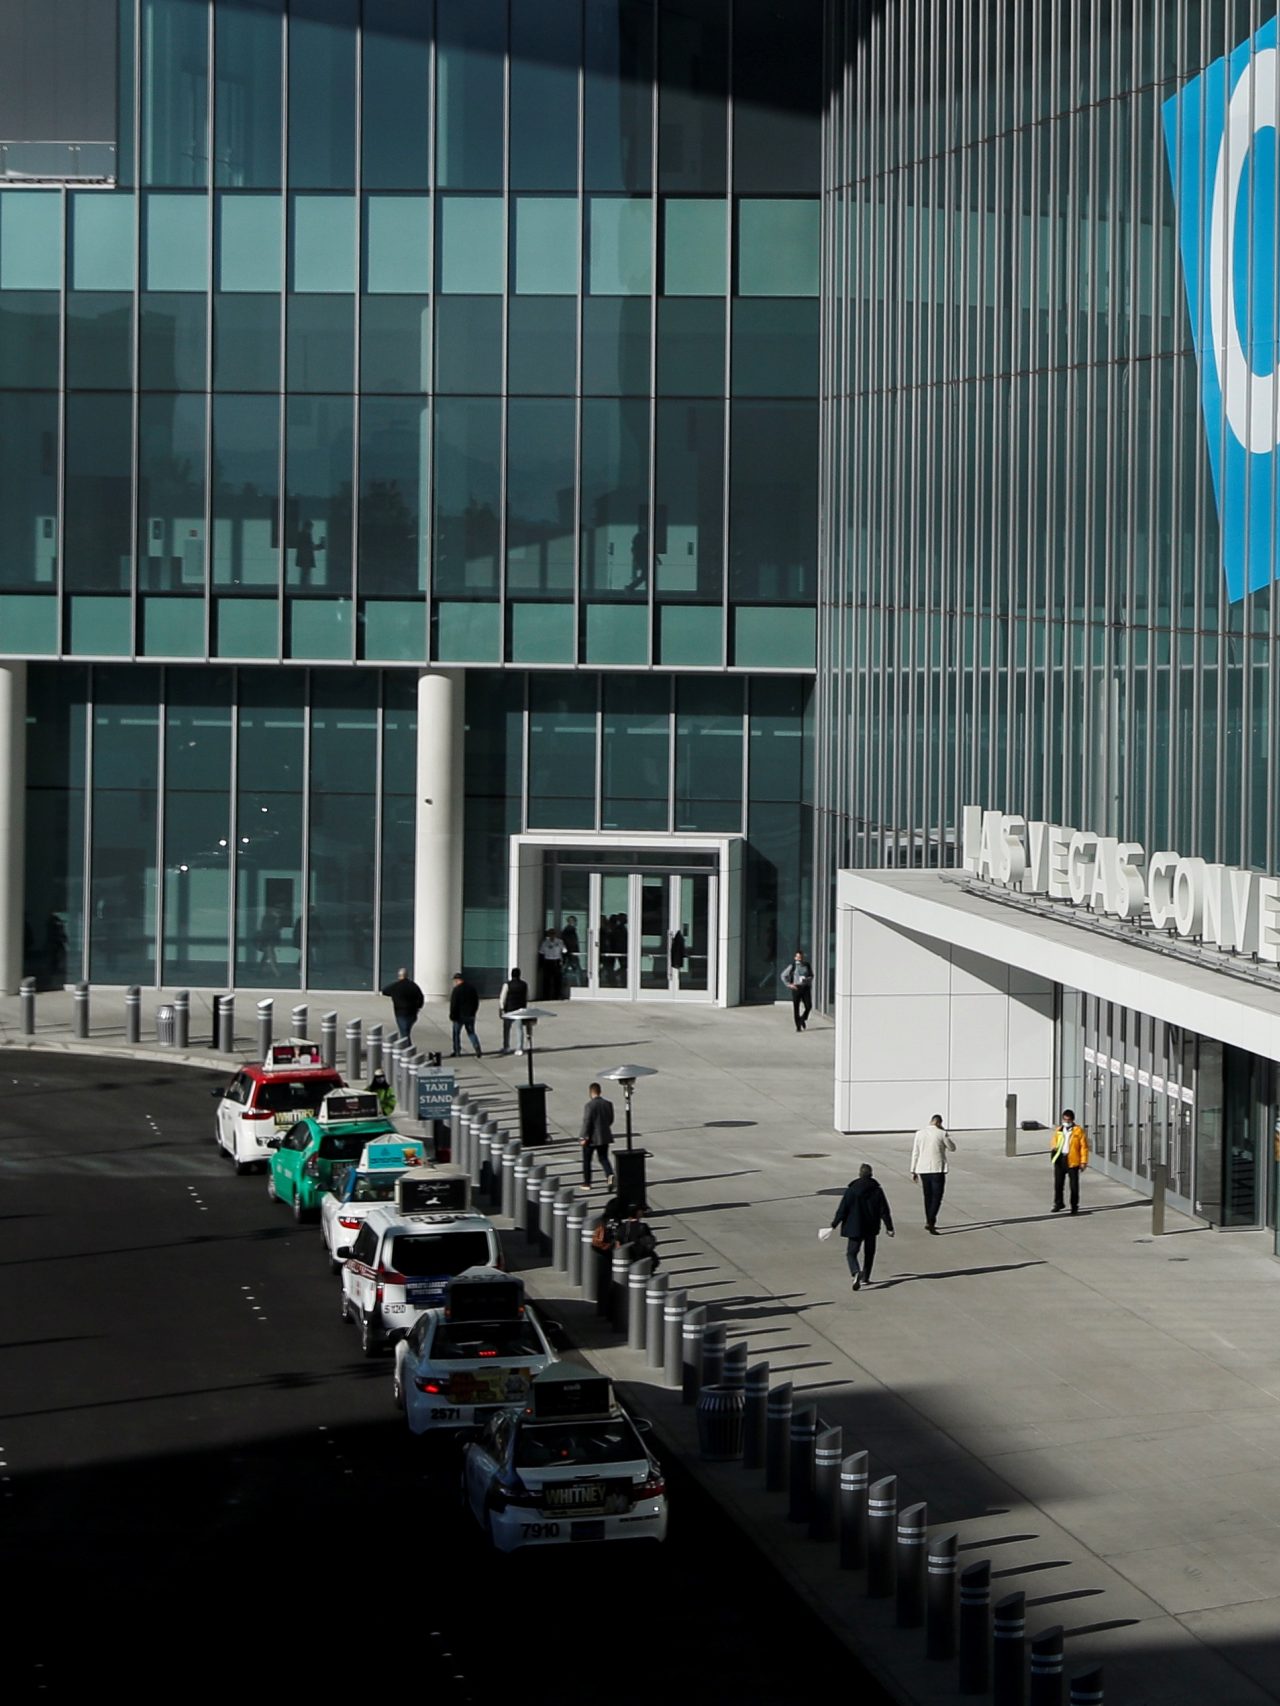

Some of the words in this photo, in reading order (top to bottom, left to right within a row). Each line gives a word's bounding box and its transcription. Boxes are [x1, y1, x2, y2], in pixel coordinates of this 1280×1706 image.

[963, 805, 1026, 884] LAS
[1028, 820, 1146, 918] VEGAS
[425, 1083, 448, 1092] TAXI
[419, 1095, 453, 1104] STAND
[431, 1408, 460, 1420] 2571
[545, 1482, 606, 1505] WHITNEY
[521, 1522, 559, 1539] 7910
